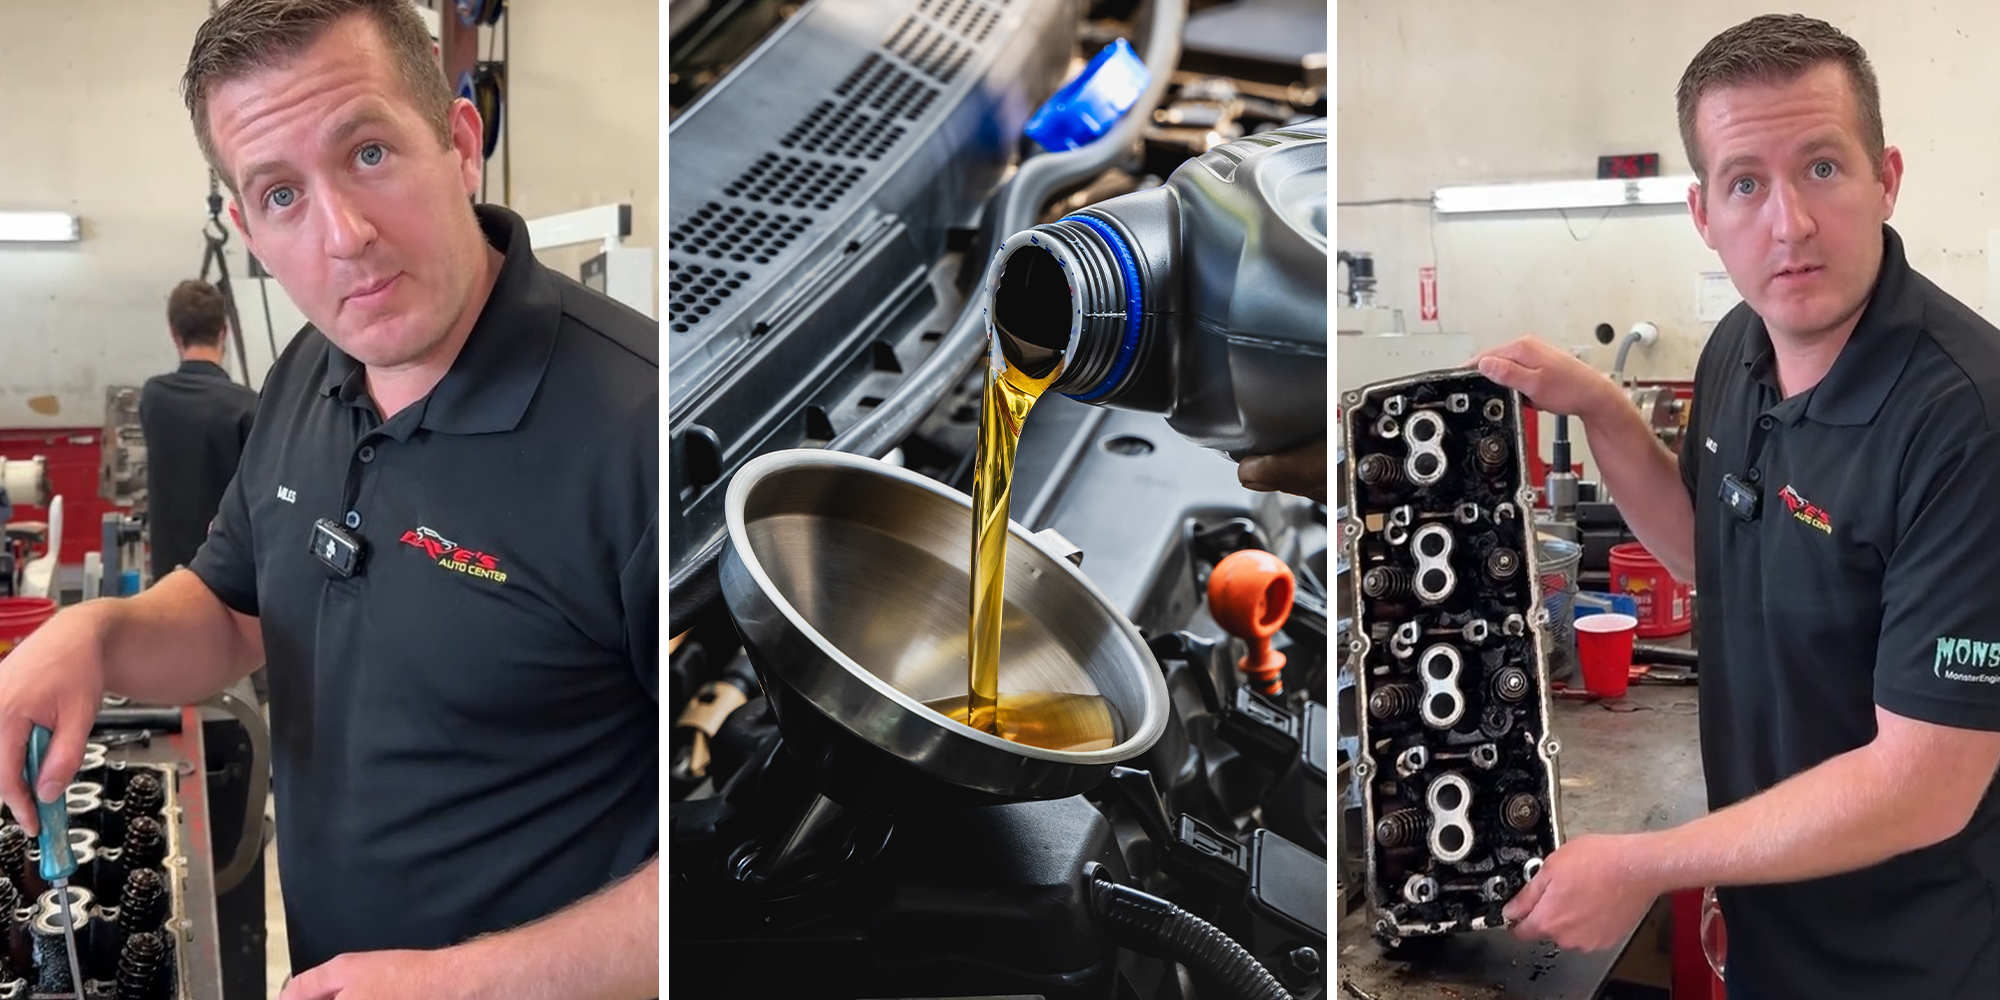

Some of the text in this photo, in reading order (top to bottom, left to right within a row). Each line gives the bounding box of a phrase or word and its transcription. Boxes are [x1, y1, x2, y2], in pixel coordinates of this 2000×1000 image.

[399, 530, 500, 571] DAVE'S
[438, 558, 508, 582] AUTO CENTER
[1933, 636, 2000, 679] MONS
